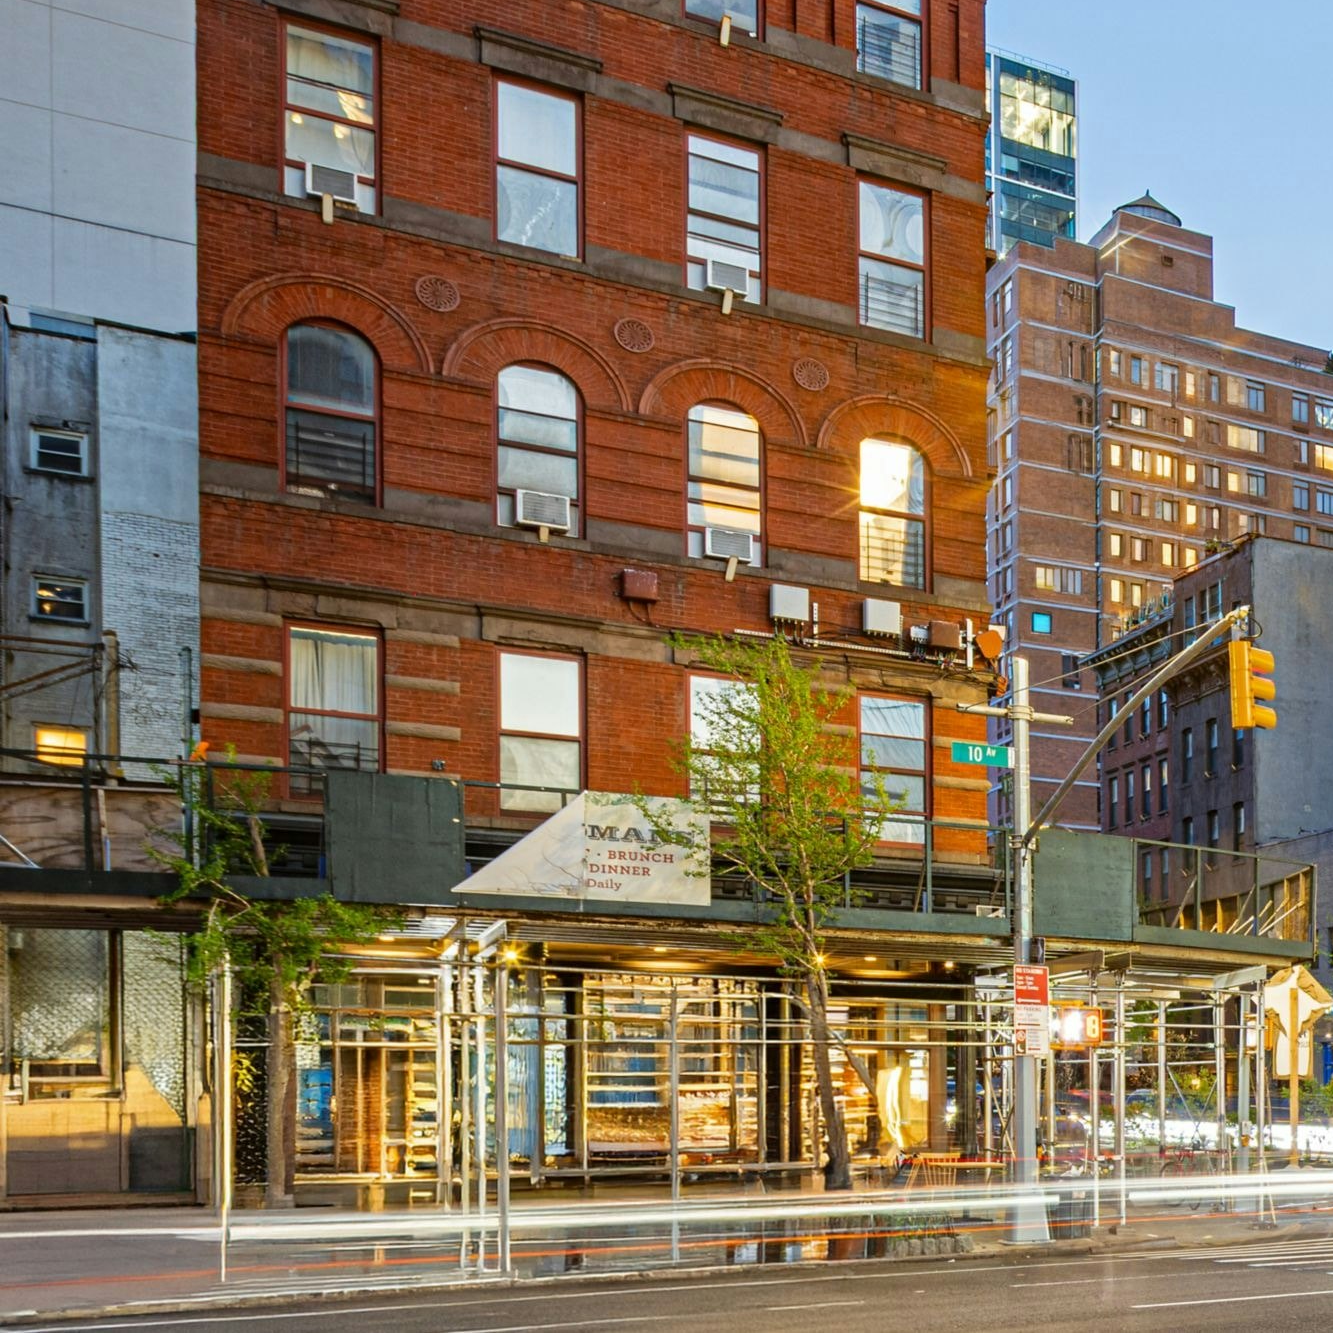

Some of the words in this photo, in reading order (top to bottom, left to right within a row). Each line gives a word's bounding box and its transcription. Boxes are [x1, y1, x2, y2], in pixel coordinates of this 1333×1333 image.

[968, 745, 983, 762] 10
[985, 746, 997, 757] Av
[607, 850, 674, 864] BRUNCH
[589, 863, 651, 876] DINNER
[586, 878, 622, 892] Daily
